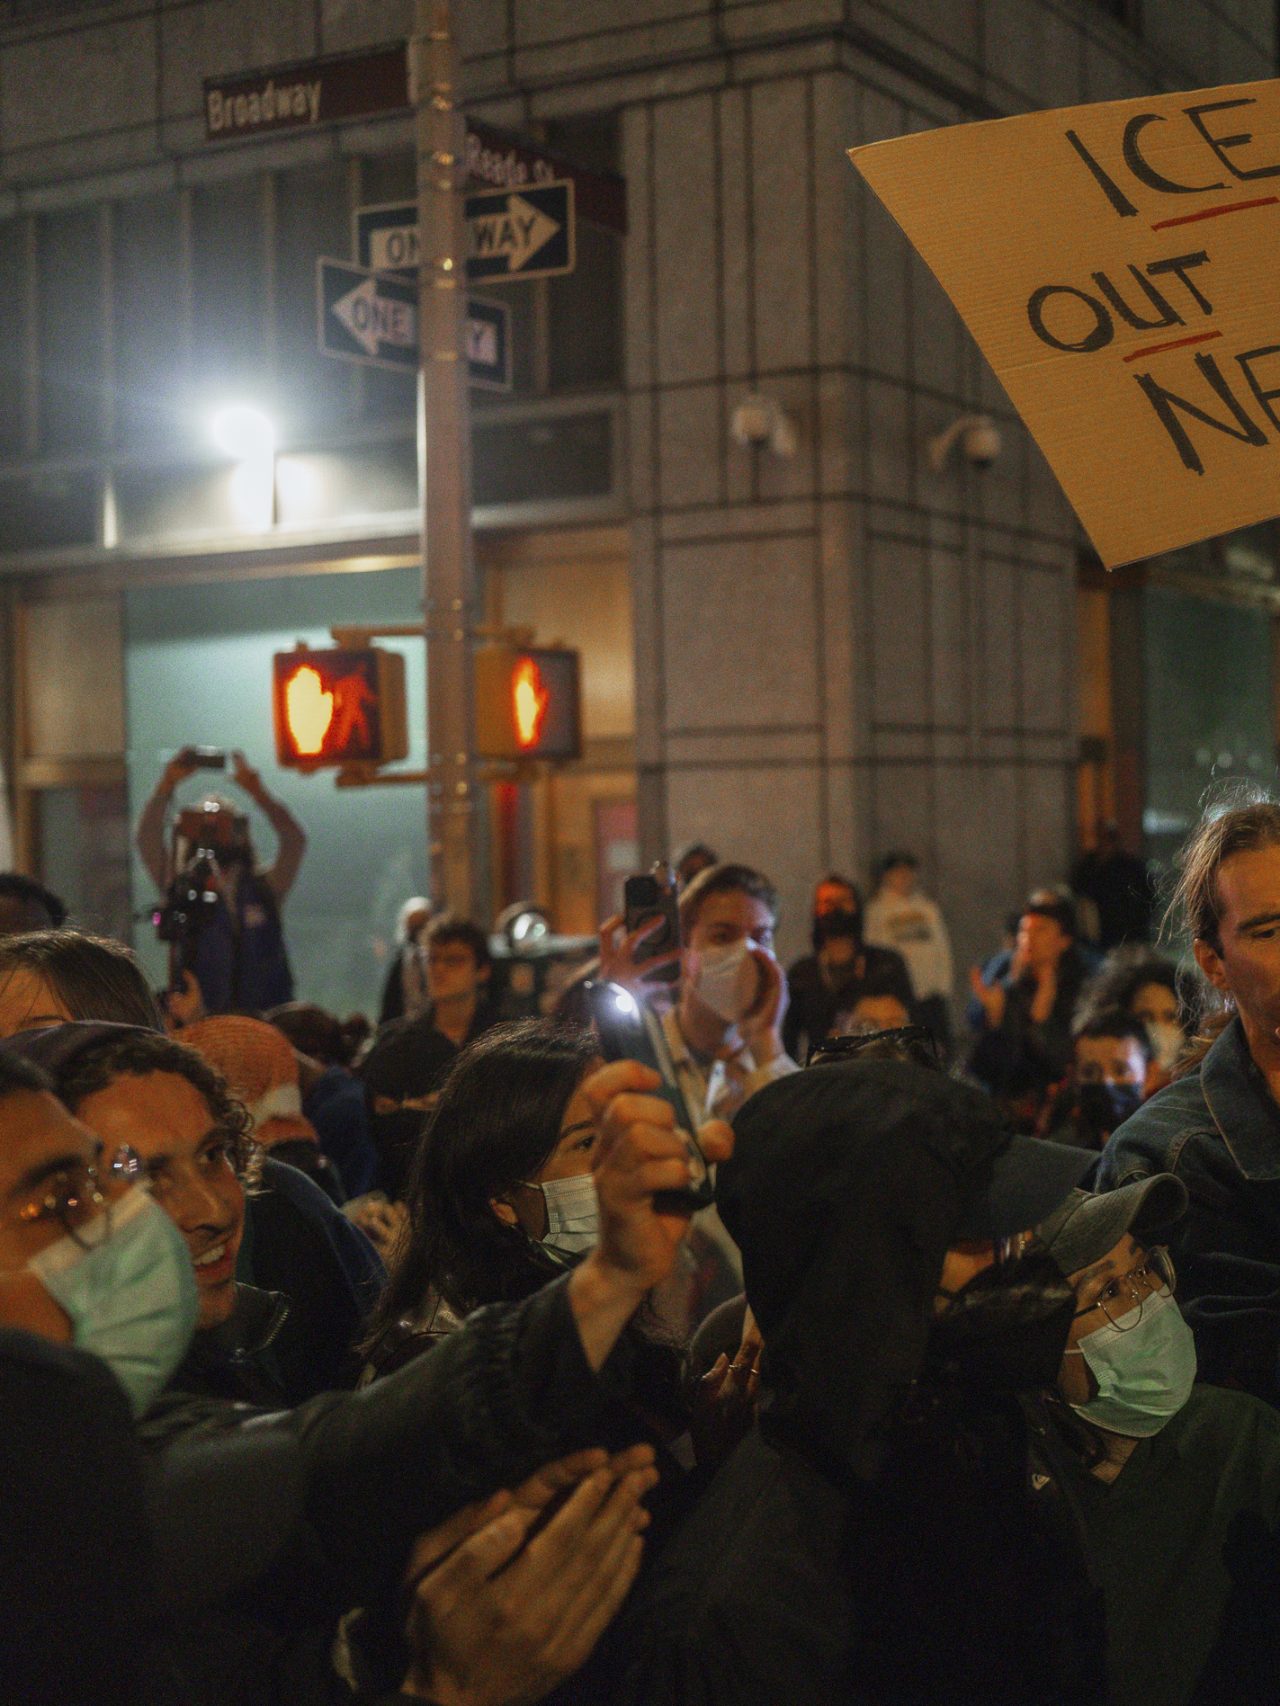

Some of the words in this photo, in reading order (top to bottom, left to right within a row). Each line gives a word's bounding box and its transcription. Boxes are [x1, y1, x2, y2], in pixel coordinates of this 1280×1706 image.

[208, 80, 322, 131] Broadway
[471, 213, 537, 253] WAY
[1028, 250, 1213, 353] OUT
